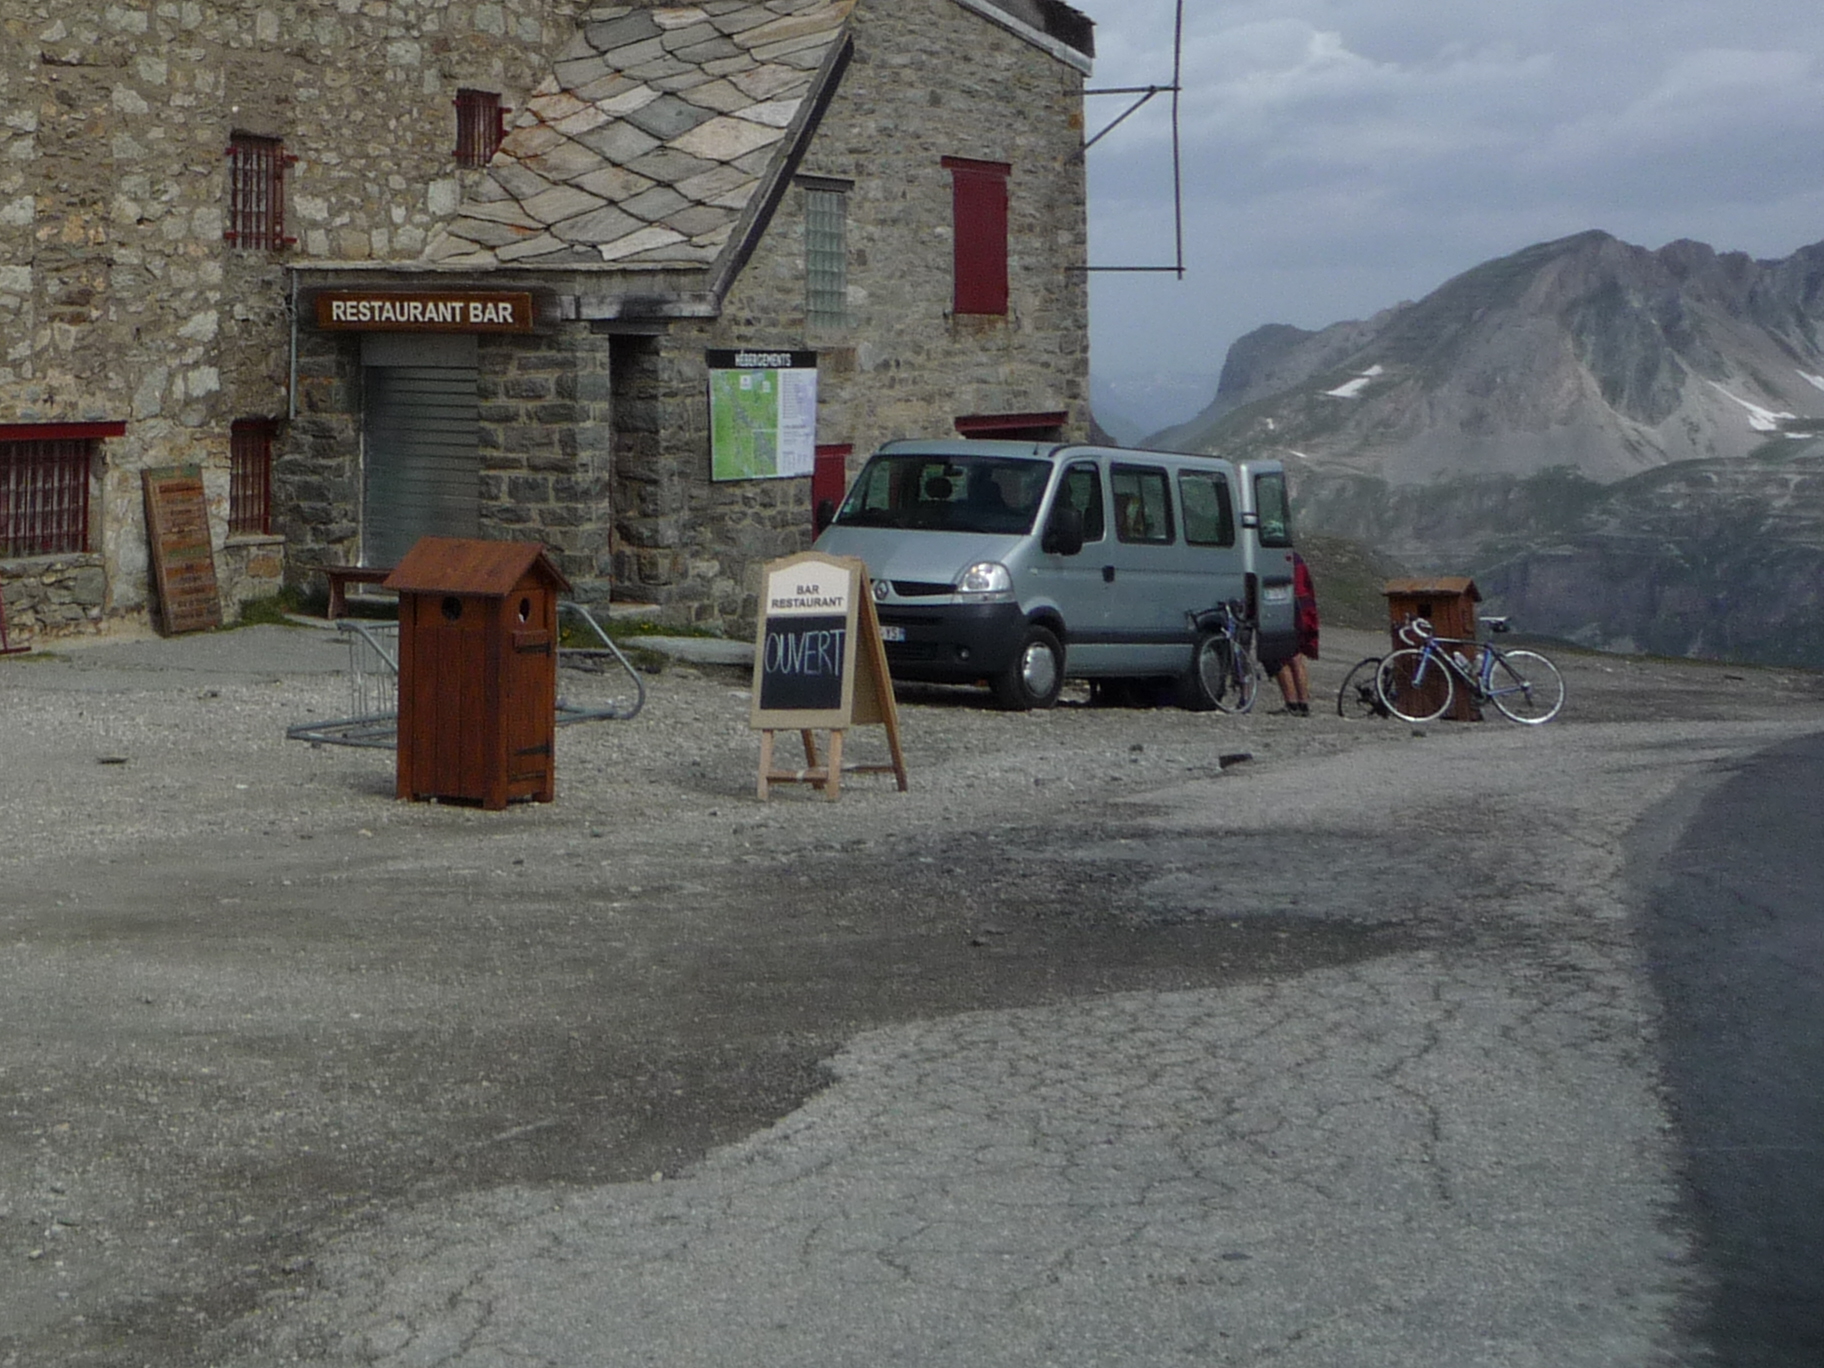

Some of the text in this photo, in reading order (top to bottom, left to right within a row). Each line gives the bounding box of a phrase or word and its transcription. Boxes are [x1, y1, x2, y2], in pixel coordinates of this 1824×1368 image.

[331, 300, 514, 324] RESTAURANT BAR
[796, 584, 820, 596] BAR
[771, 597, 844, 610] RESTAURANT
[764, 628, 846, 677] OUVERT
